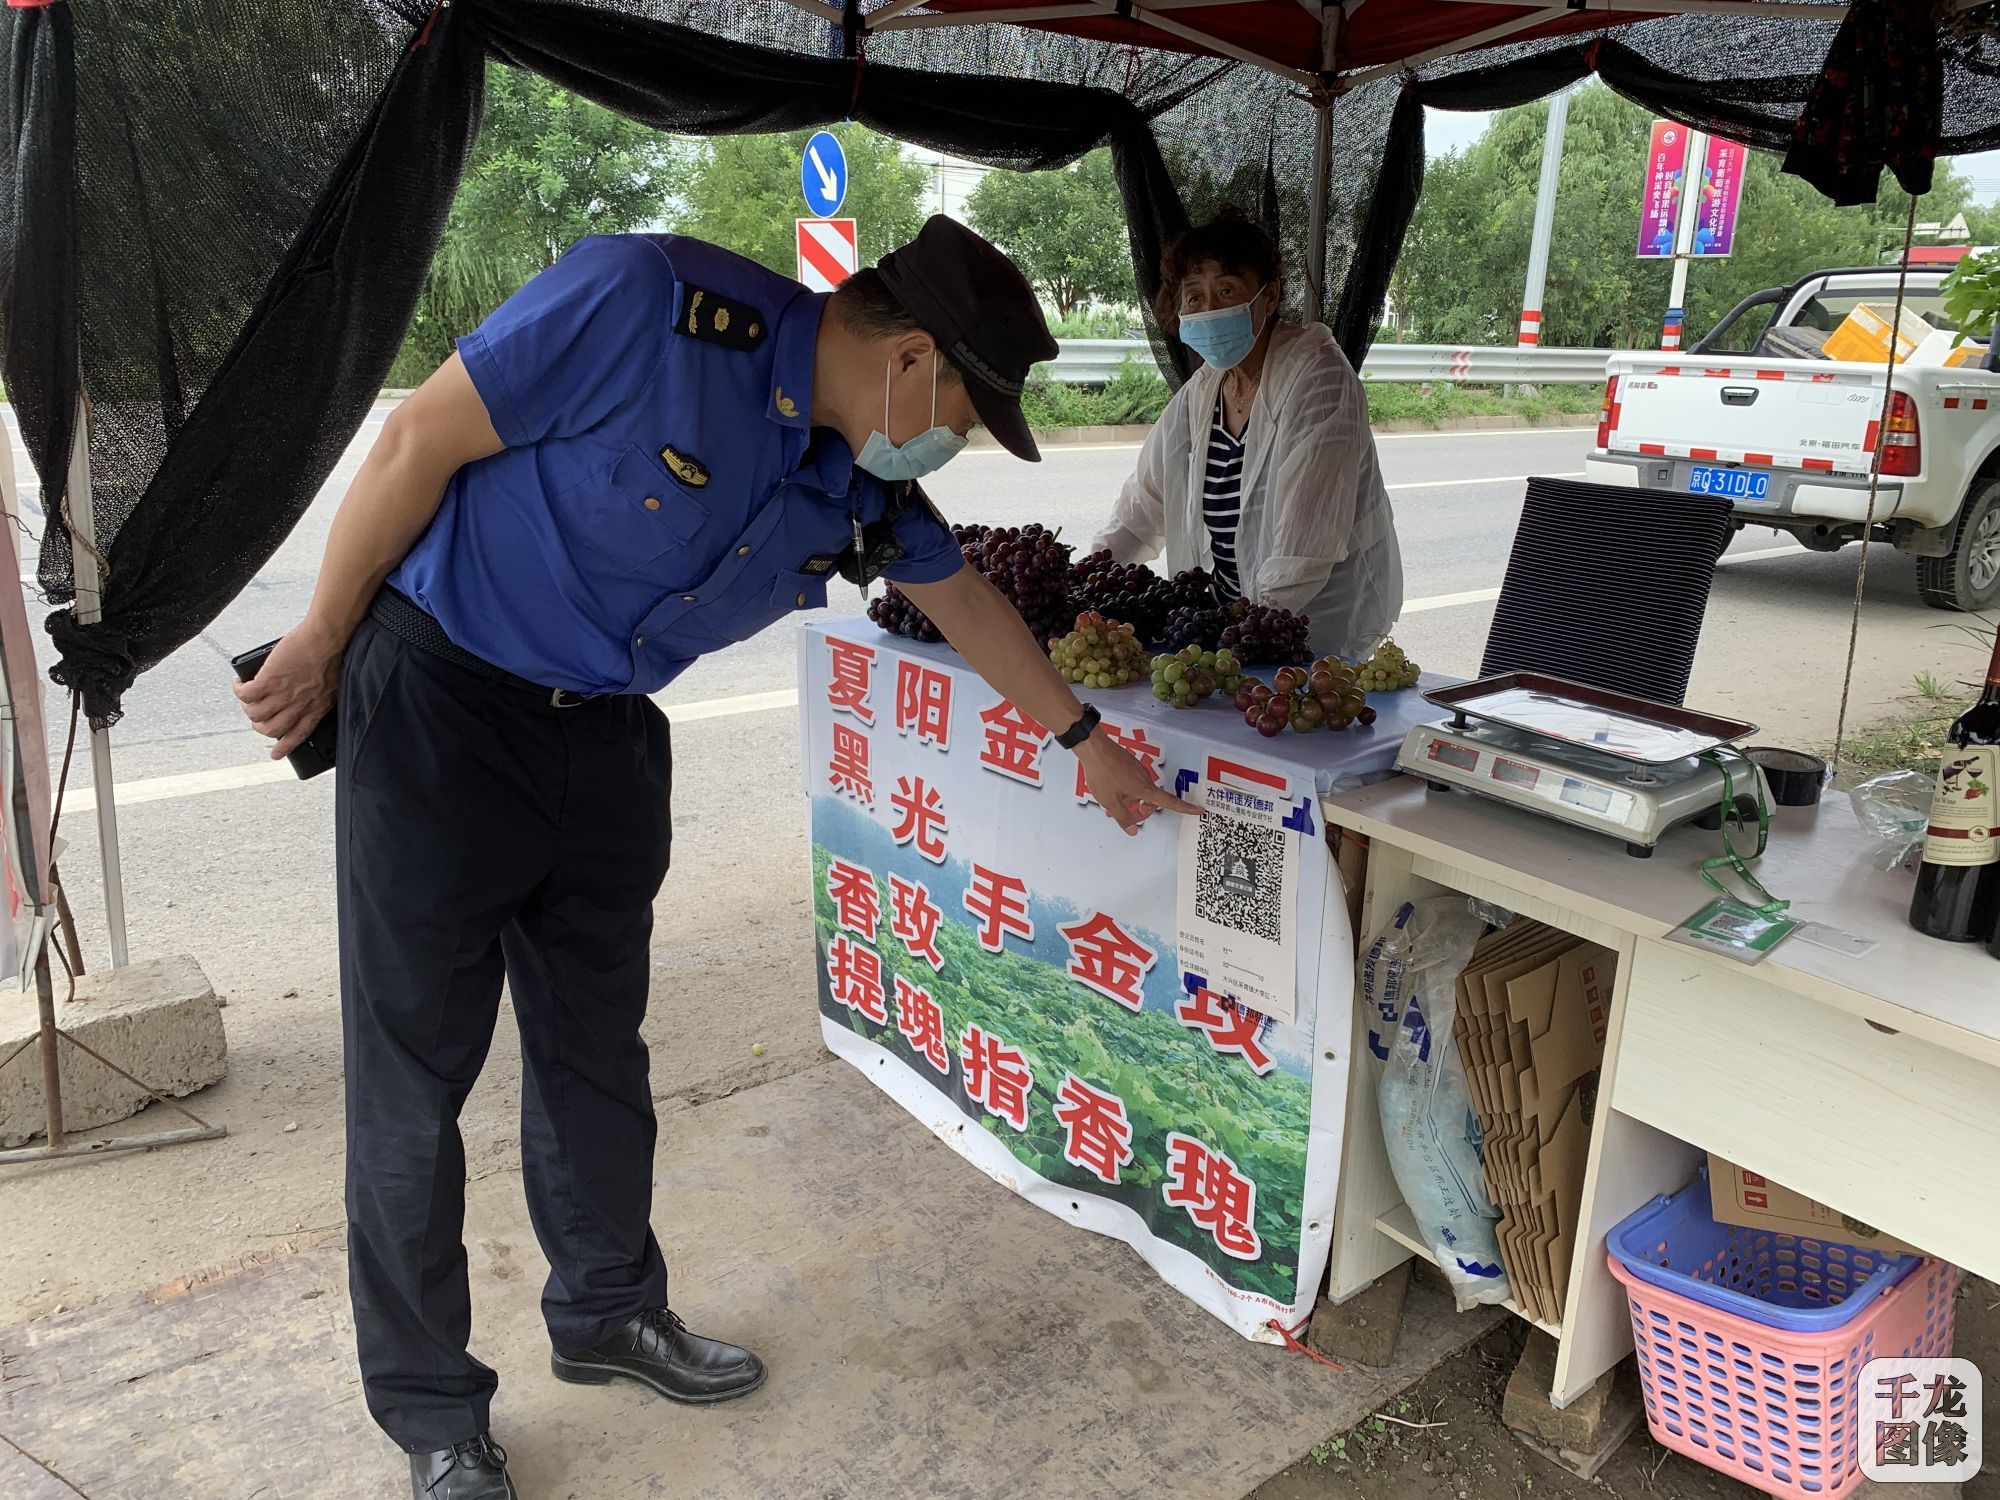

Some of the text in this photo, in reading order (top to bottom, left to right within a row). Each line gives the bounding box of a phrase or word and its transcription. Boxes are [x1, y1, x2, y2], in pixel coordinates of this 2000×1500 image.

[1709, 148, 1728, 236] 采育葡萄旅游文化节
[825, 636, 875, 803] 夏黑
[1207, 787, 1274, 813] 大件快递发德邦
[829, 864, 885, 1021] 香提
